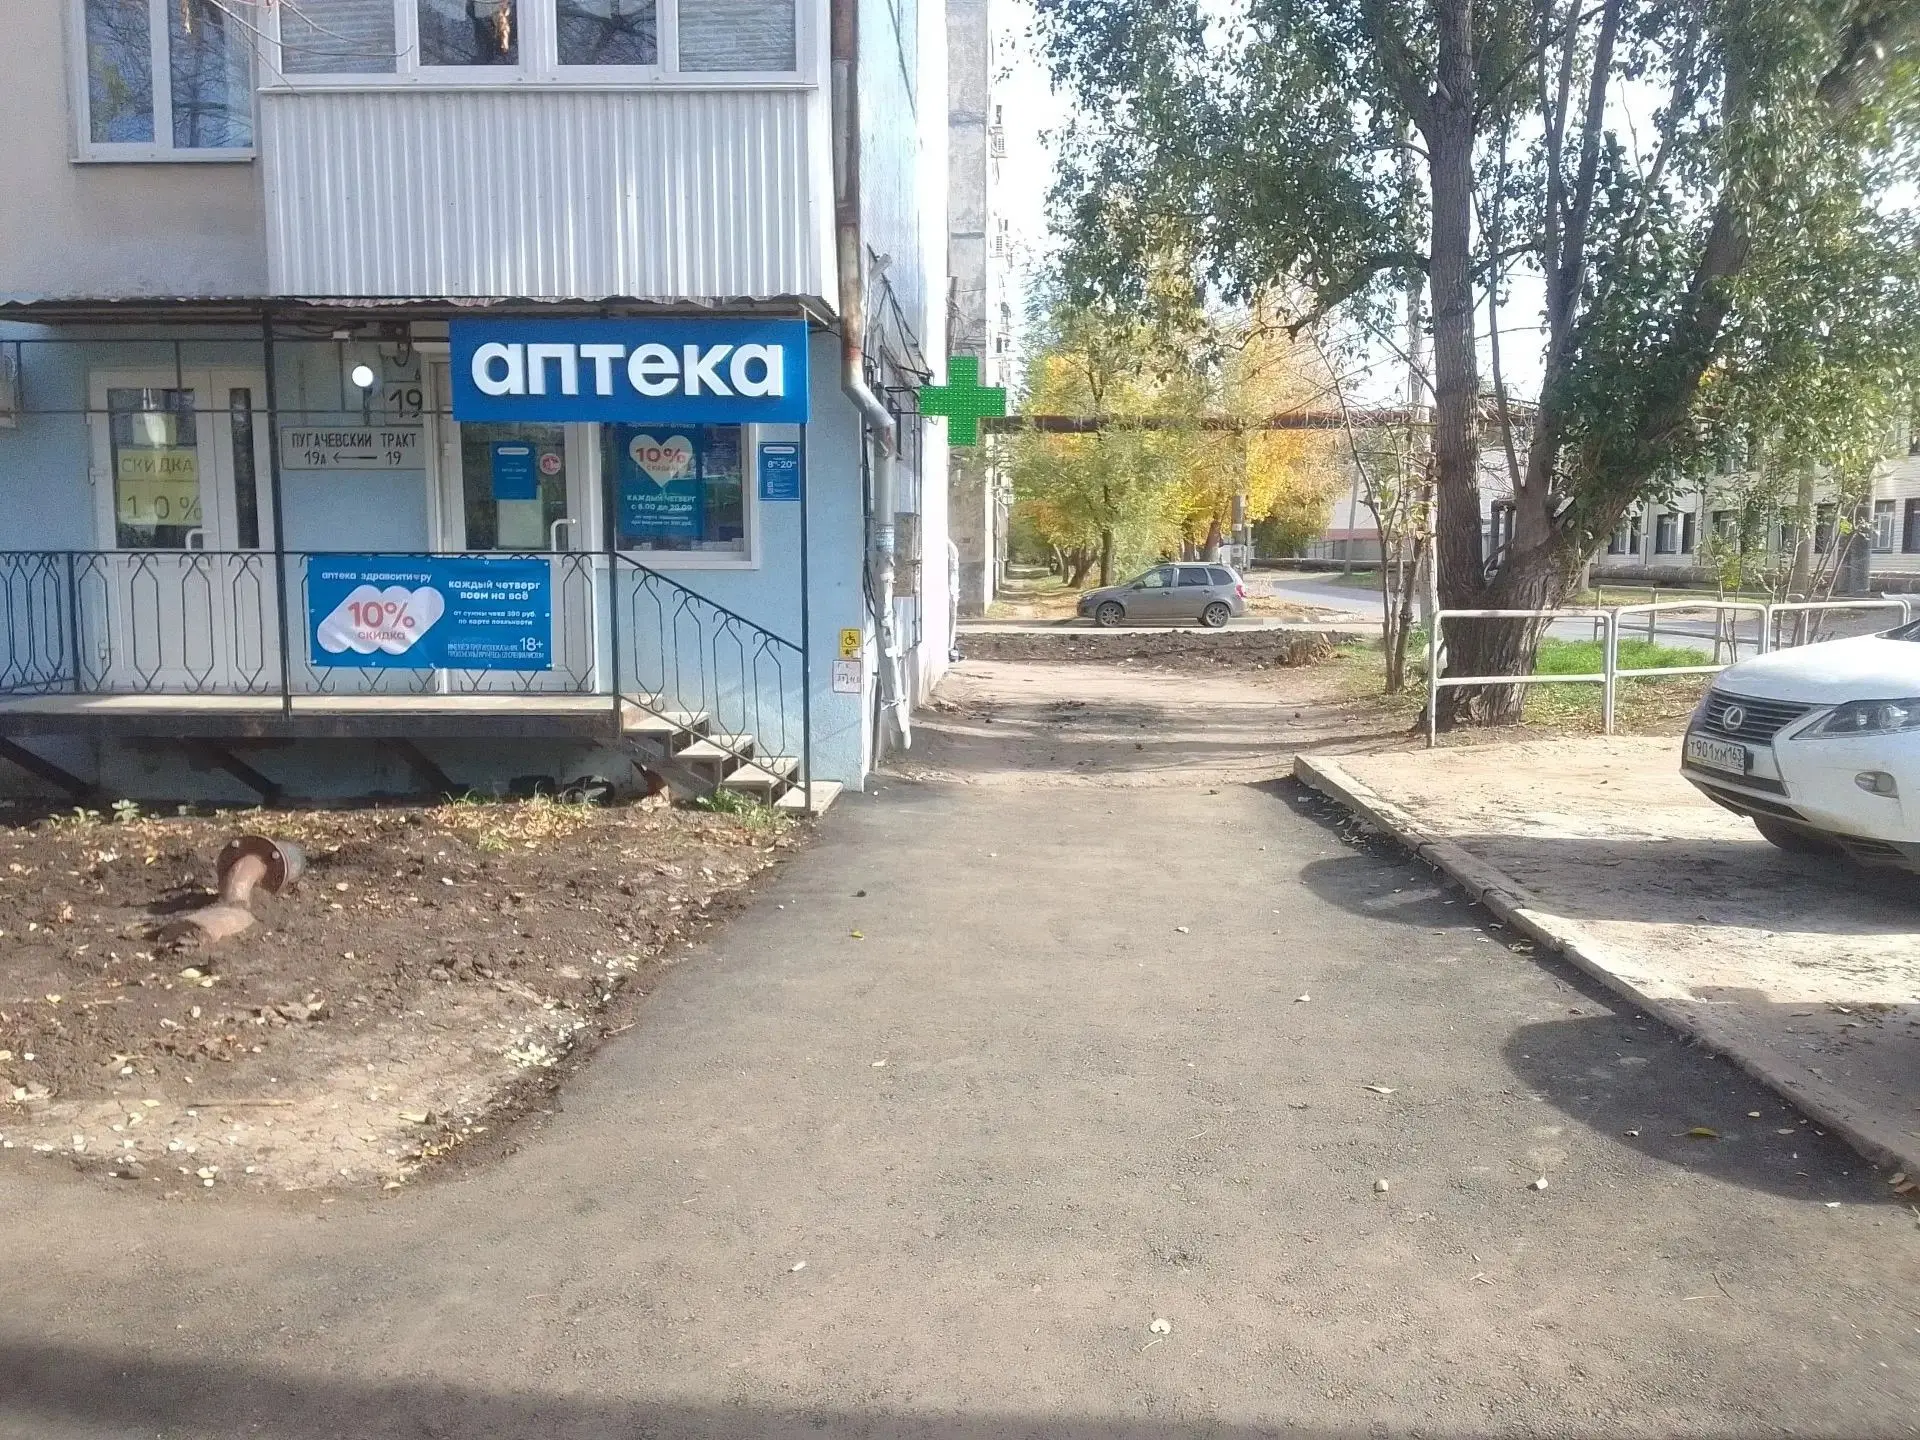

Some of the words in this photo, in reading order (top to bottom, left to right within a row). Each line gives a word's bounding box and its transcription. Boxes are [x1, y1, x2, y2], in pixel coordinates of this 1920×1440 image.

[471, 342, 784, 397] аптека
[389, 389, 423, 418] 19
[381, 433, 416, 448] ТРАКТ
[385, 451, 402, 465] 19
[636, 447, 686, 462] 10%
[121, 457, 194, 476] СКИДКА
[321, 571, 357, 580] аптека
[448, 580, 493, 589] каждый
[495, 582, 541, 591] четверг
[460, 592, 489, 600] всем
[347, 601, 416, 628] 10%
[357, 631, 406, 641] скидка
[519, 637, 544, 652] 18+
